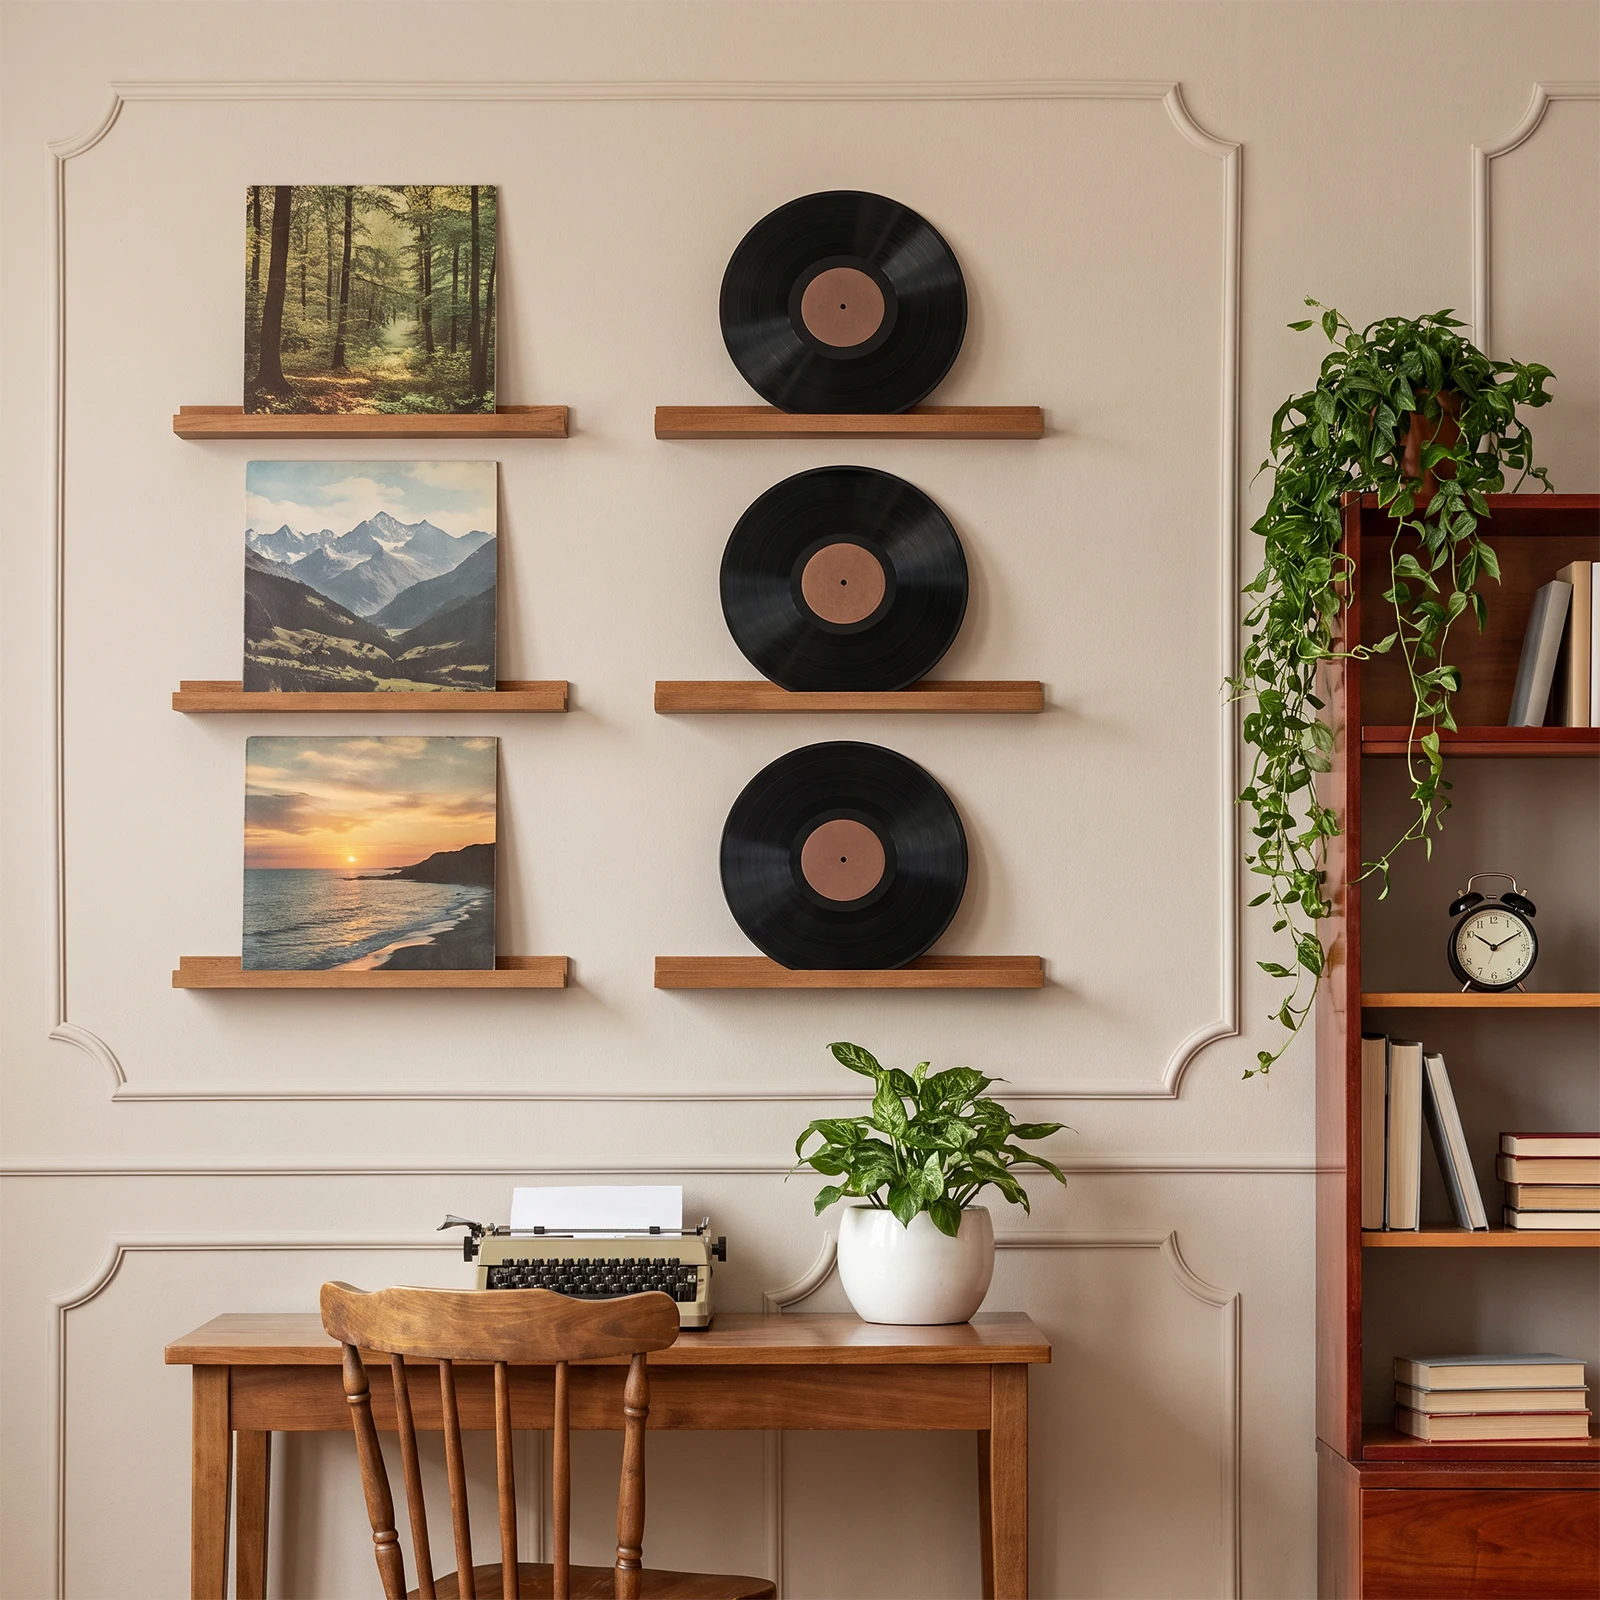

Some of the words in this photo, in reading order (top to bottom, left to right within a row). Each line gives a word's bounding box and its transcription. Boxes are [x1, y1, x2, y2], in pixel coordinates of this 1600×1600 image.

[1489, 916, 1498, 924] 12
[1506, 919, 1510, 928] 1
[1476, 920, 1483, 929] 11
[1466, 930, 1474, 939] 10
[1461, 944, 1467, 952] 9
[1520, 944, 1526, 952] 3
[1466, 958, 1472, 966] 8
[1515, 958, 1521, 966] 4
[1477, 968, 1483, 976] 7
[1491, 971, 1498, 979] 6
[1506, 968, 1513, 976] 5
